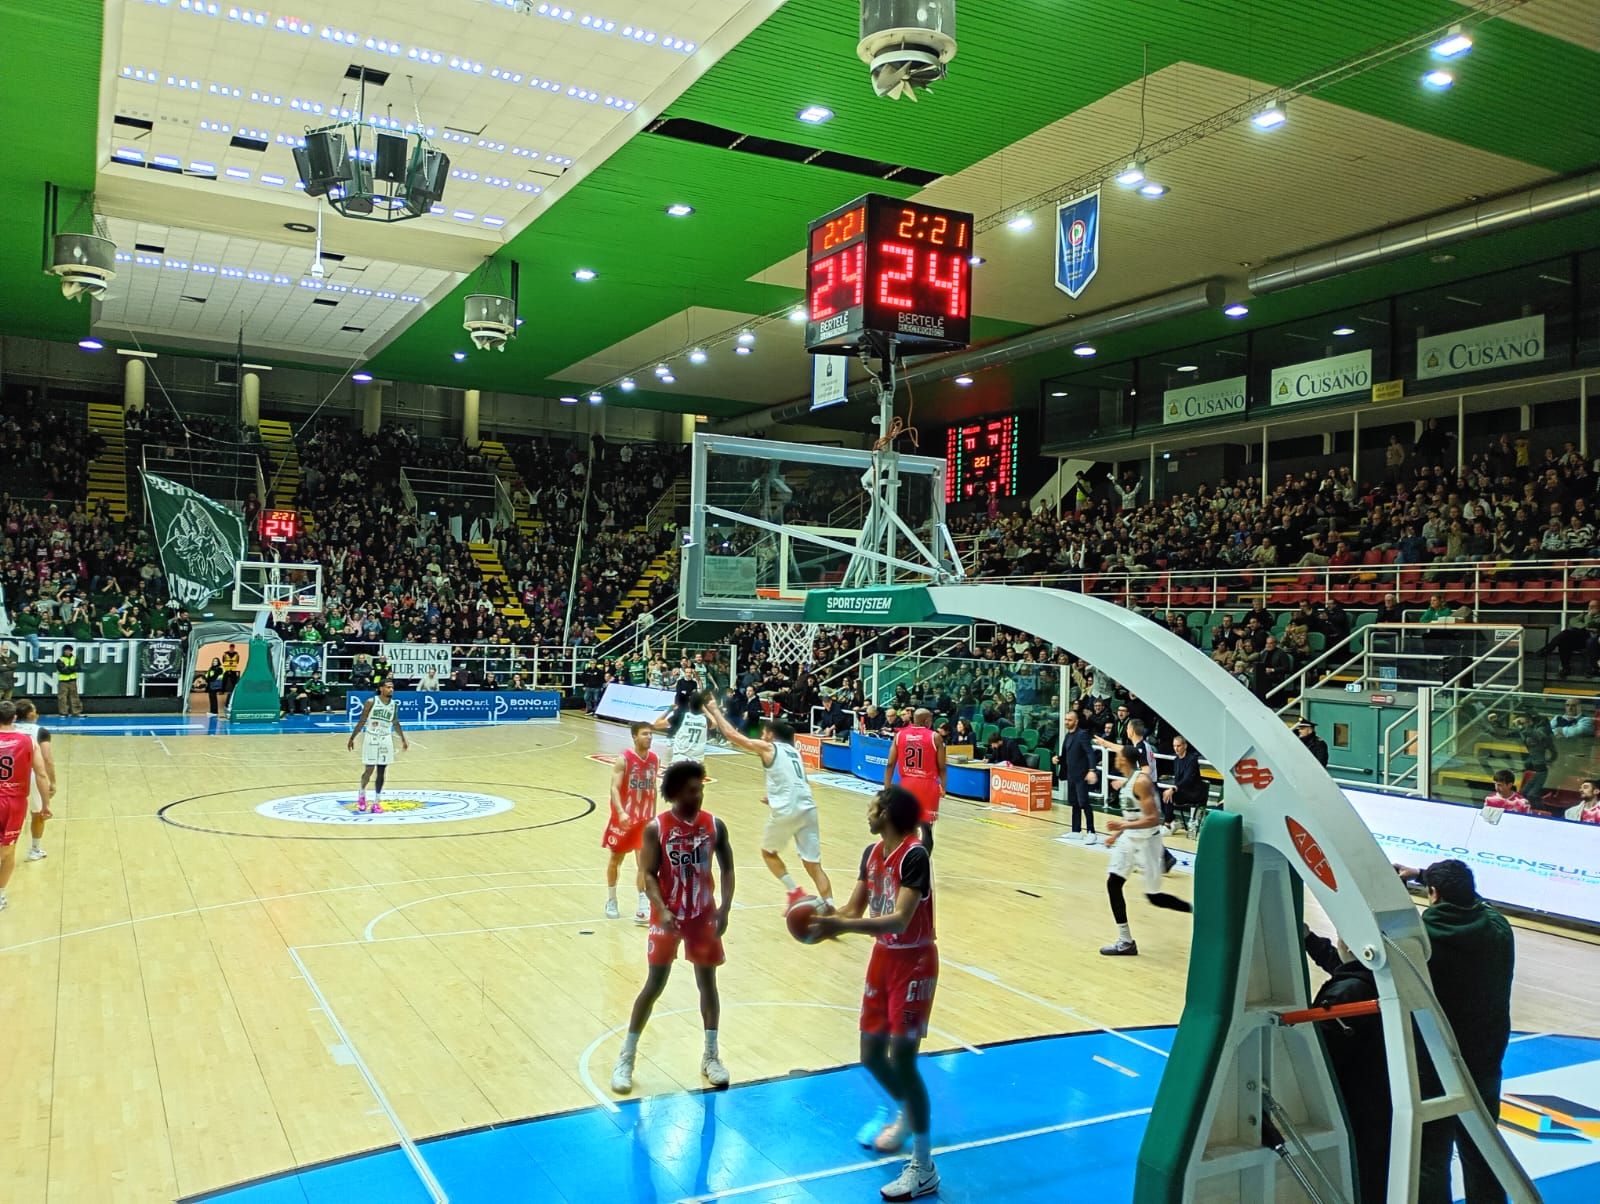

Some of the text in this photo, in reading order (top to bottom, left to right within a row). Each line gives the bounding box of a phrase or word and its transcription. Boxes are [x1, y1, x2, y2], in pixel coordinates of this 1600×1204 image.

[824, 207, 865, 250] 2:21
[898, 209, 965, 248] 2:21
[813, 245, 863, 320] 24
[880, 243, 961, 316] 24
[1449, 338, 1540, 370] CUSANO
[1295, 370, 1368, 397] CUSANO
[1184, 394, 1245, 417] CUSANO
[272, 512, 295, 520] 2:21
[266, 520, 293, 536] 24
[393, 663, 414, 675] LUB
[688, 728, 702, 743] 77
[792, 760, 803, 779] 0
[905, 747, 924, 769] 21
[1001, 780, 1029, 793] DURING
[1295, 832, 1330, 876] ACE
